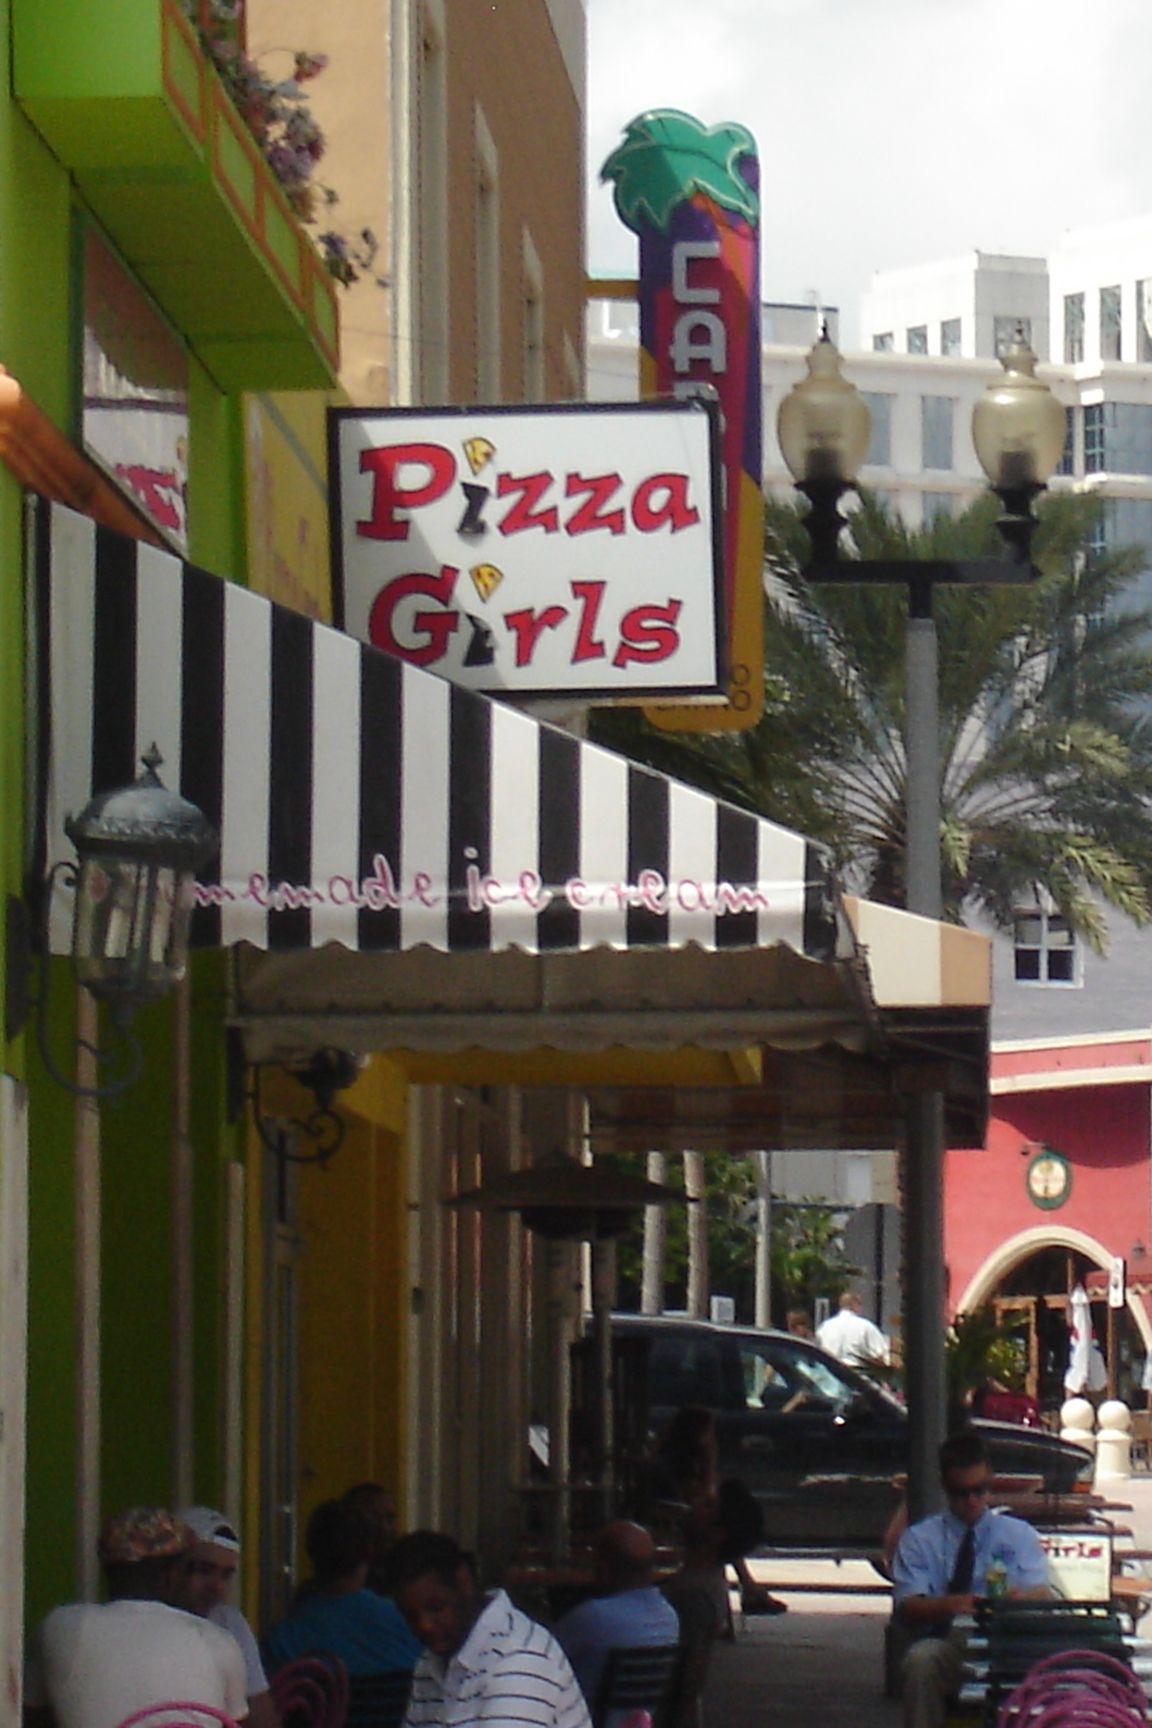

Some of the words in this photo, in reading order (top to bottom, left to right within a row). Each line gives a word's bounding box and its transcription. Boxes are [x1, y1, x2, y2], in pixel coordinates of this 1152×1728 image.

[354, 436, 702, 541] Pizza
[367, 562, 684, 669] Girls
[190, 852, 441, 911] memade
[464, 846, 551, 914] ice
[565, 869, 770, 916] cream
